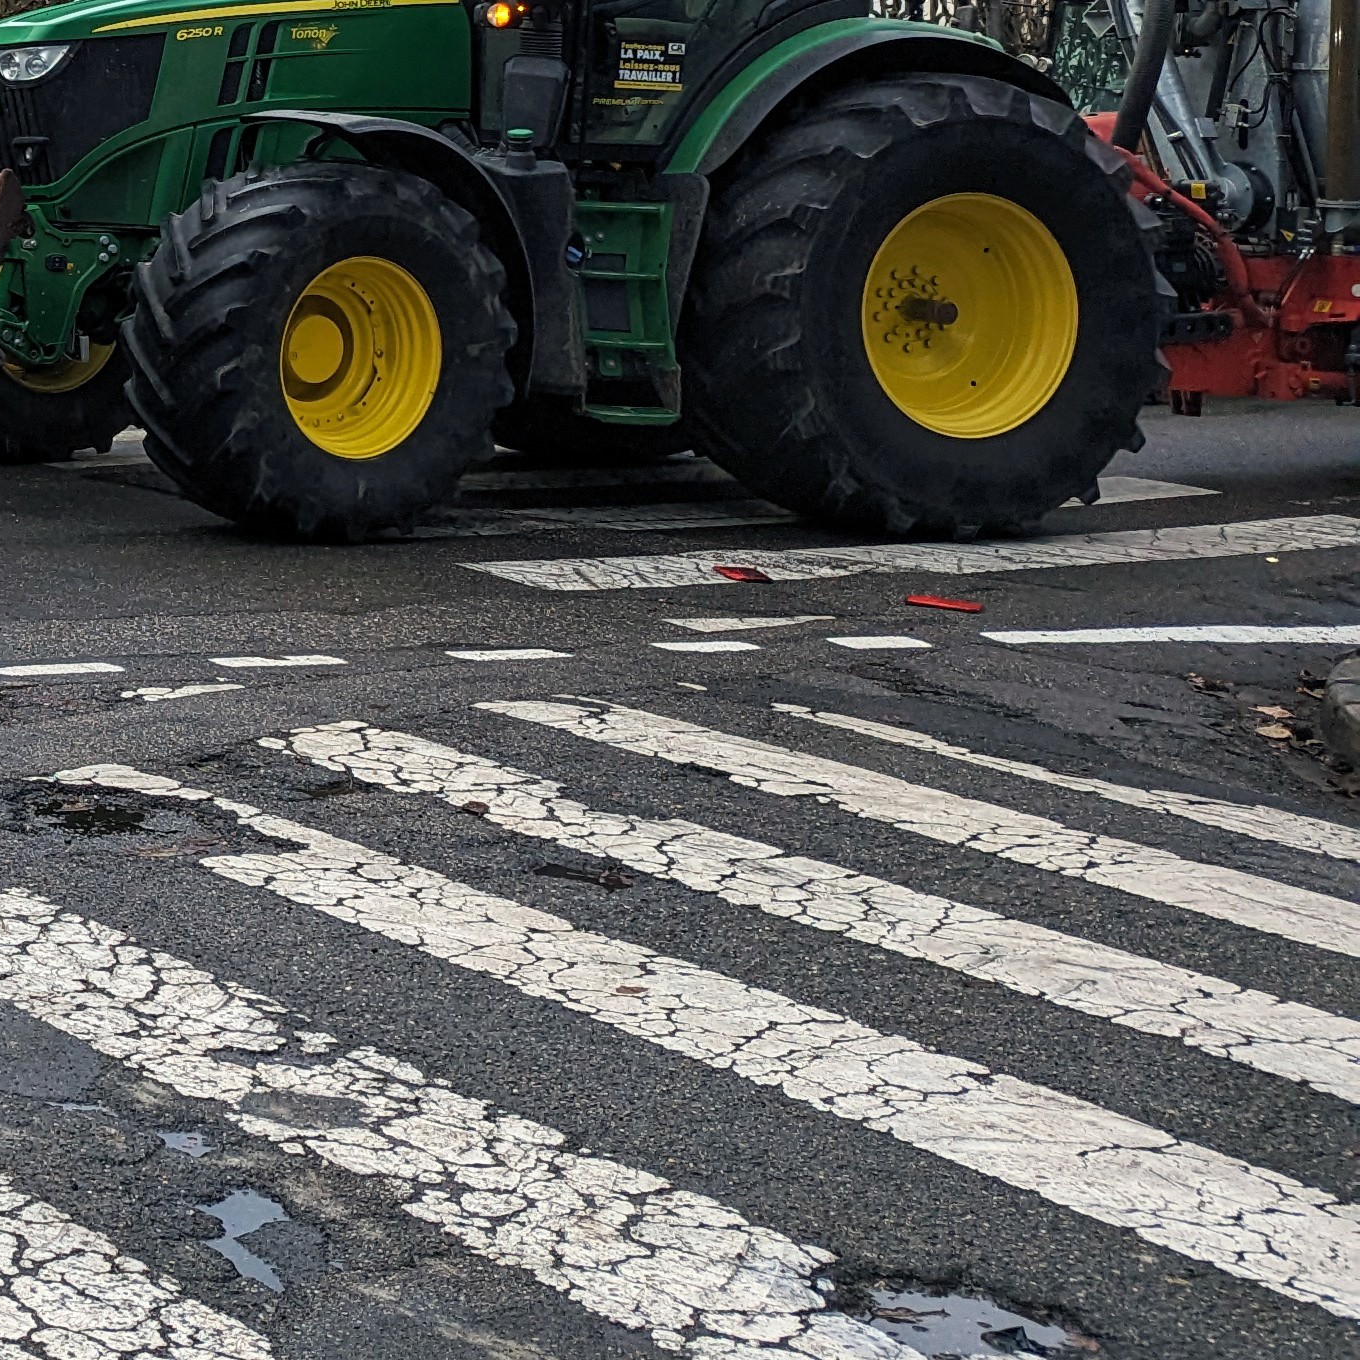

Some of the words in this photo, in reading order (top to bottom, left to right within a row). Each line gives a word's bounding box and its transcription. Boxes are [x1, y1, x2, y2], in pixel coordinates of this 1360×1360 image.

[331, 0, 358, 10] JOHN
[176, 28, 211, 41] 6250
[213, 26, 223, 37] R
[670, 43, 684, 54] CR
[620, 49, 633, 58] LA
[637, 50, 664, 61] PAIX,
[619, 60, 680, 71] Laissez-nous
[619, 70, 673, 82] TRAVAILLER
